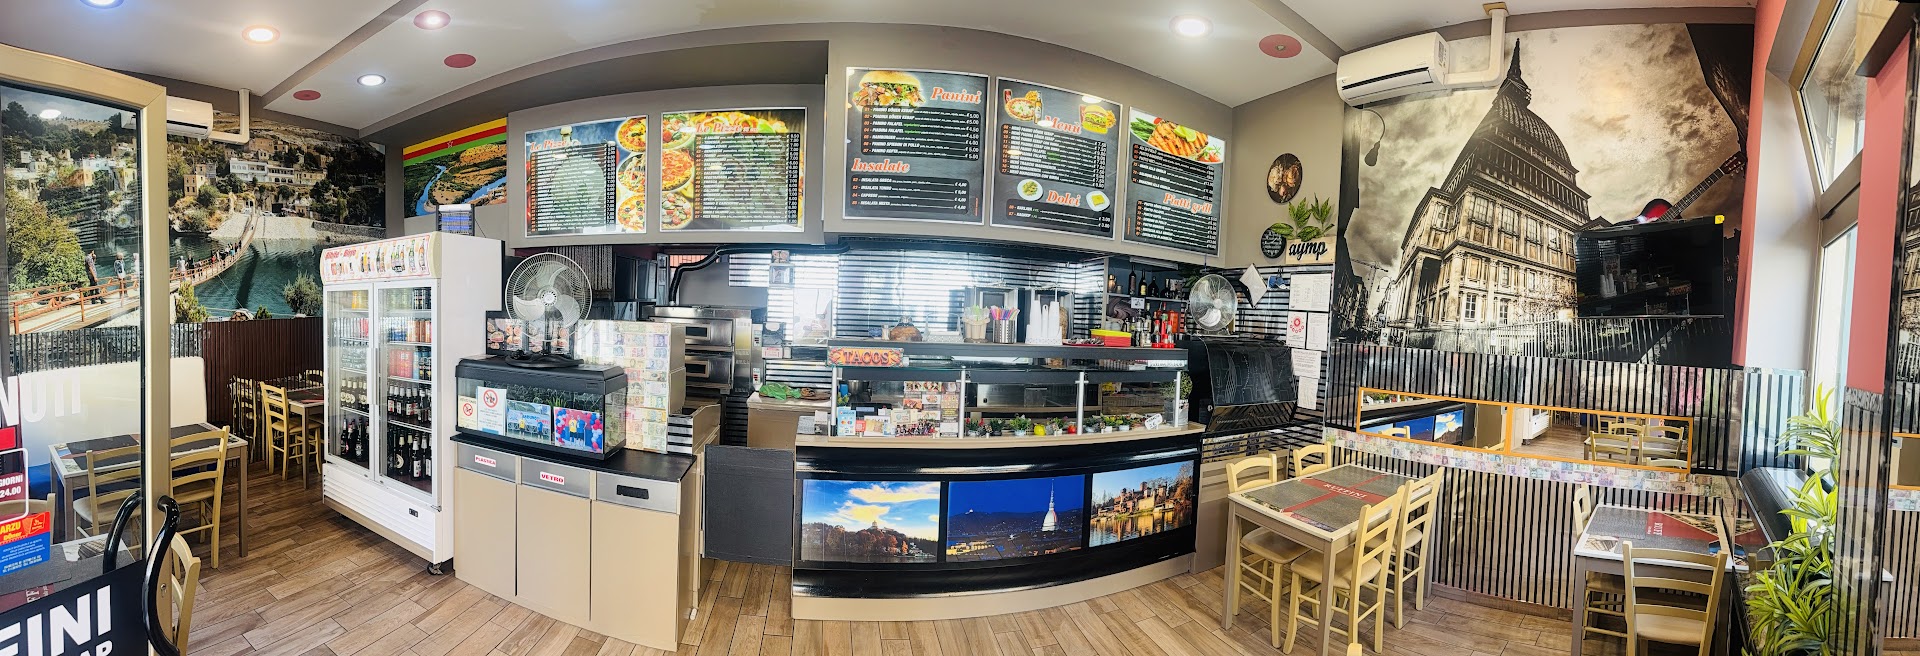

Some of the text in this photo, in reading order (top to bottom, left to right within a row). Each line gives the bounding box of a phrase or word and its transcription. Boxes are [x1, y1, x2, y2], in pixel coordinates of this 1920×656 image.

[931, 87, 981, 103] Panini
[697, 123, 709, 132] Le
[713, 122, 740, 132] Pizze
[852, 159, 910, 172] Insalate
[1048, 191, 1080, 206] Dolci
[1164, 194, 1212, 213] Piatti grill
[843, 351, 888, 364] TACOS
[476, 457, 496, 465] PLASTICA
[542, 474, 563, 483] VETRO
